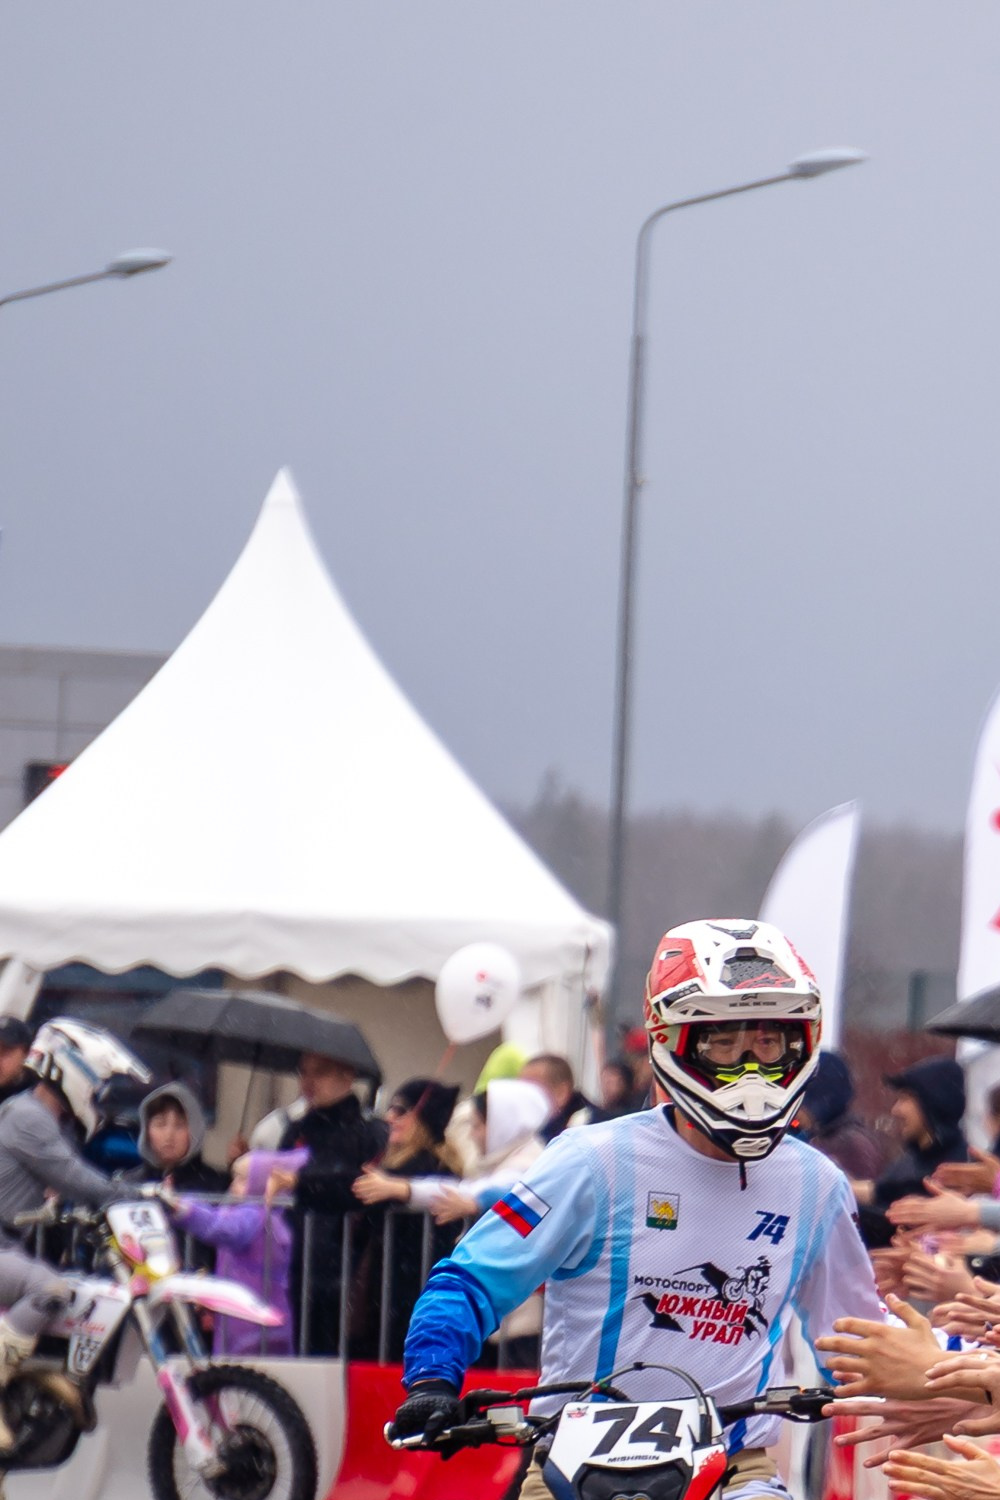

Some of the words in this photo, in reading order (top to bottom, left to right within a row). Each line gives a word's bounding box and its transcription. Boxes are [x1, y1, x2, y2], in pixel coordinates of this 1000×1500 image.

[746, 1210, 790, 1245] 74
[634, 1275, 711, 1294] МОТОСПОРТ
[656, 1293, 750, 1324] ЮЖНЫЙ
[689, 1320, 745, 1345] УРАЛ
[589, 1405, 684, 1458] 74
